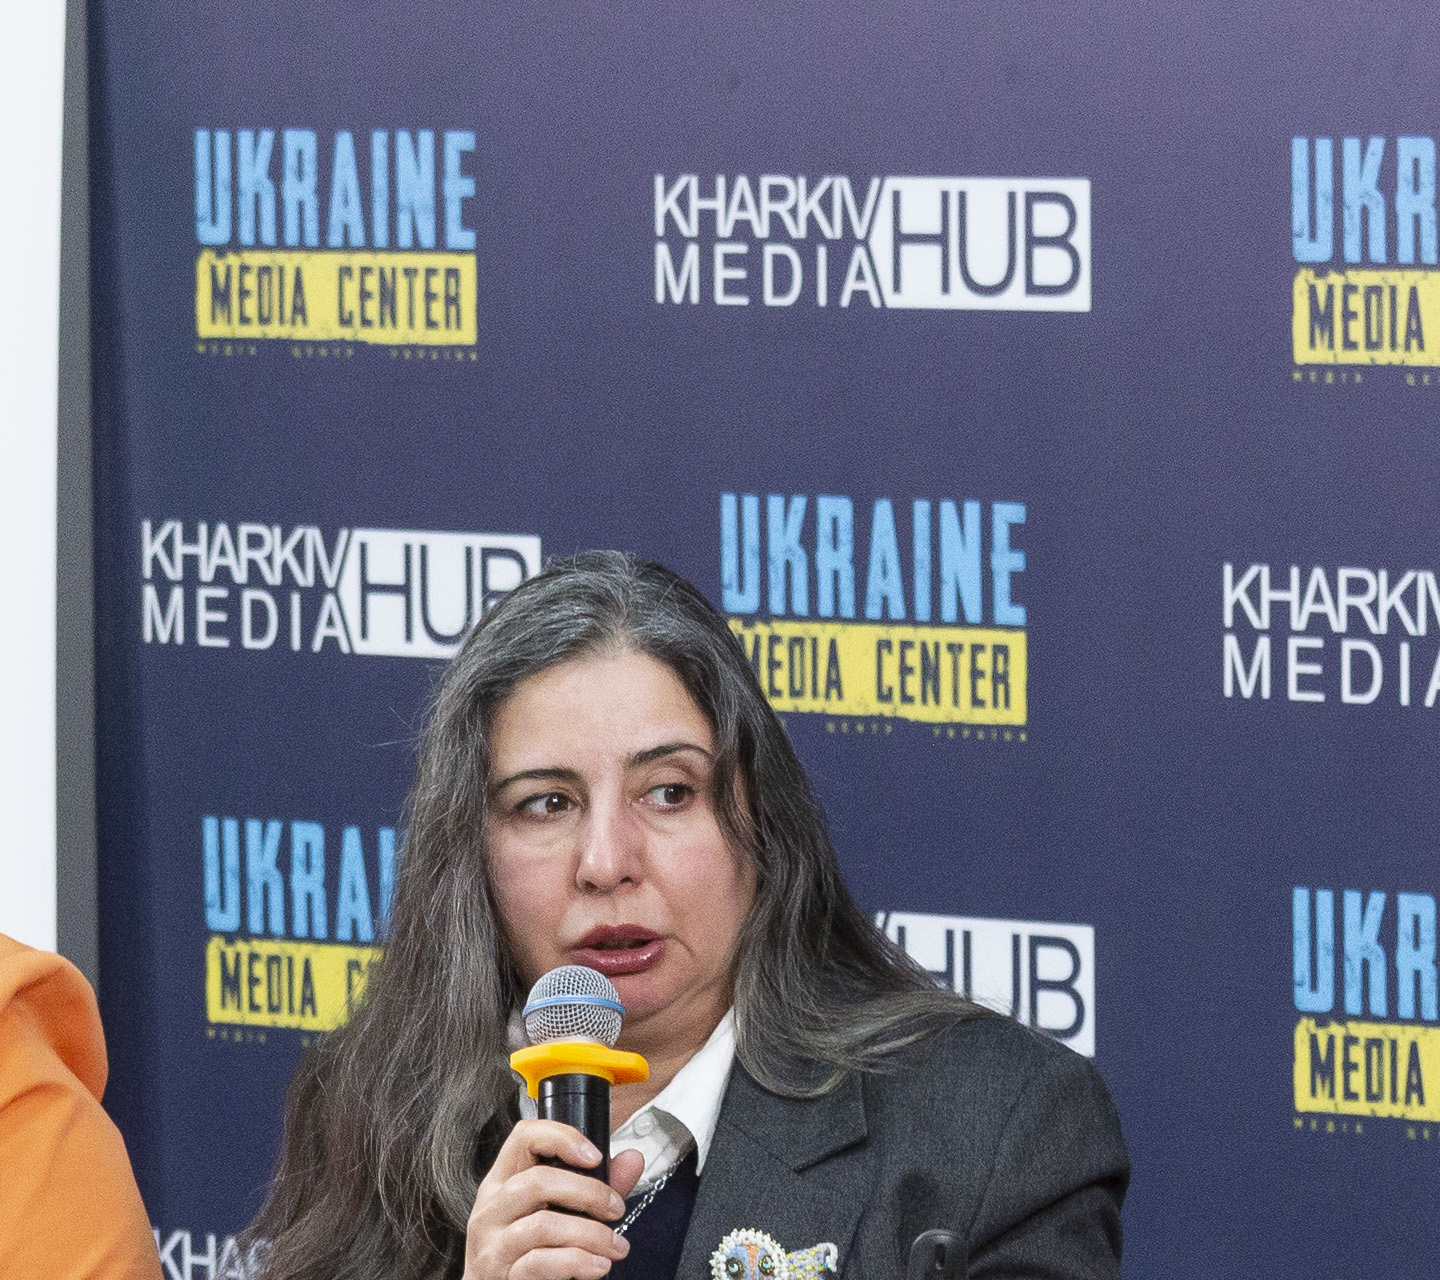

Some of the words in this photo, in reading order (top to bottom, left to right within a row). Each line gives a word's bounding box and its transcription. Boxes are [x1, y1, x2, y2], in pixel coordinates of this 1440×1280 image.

[194, 128, 477, 250] UKRAINE
[654, 174, 880, 239] KHARKIV
[654, 242, 881, 307] MEDIA
[892, 190, 1081, 298] HUB
[210, 264, 308, 327] MEDIA
[338, 265, 462, 330] CENTER
[1308, 283, 1425, 352] MEDIA
[142, 520, 350, 588] KHARKIV
[721, 493, 1027, 626] UKRAINE
[142, 584, 351, 654] MEDIA
[876, 639, 1010, 710] CENTER
[220, 951, 318, 1018] MEDIA
[1309, 1034, 1425, 1107] MEDIA
